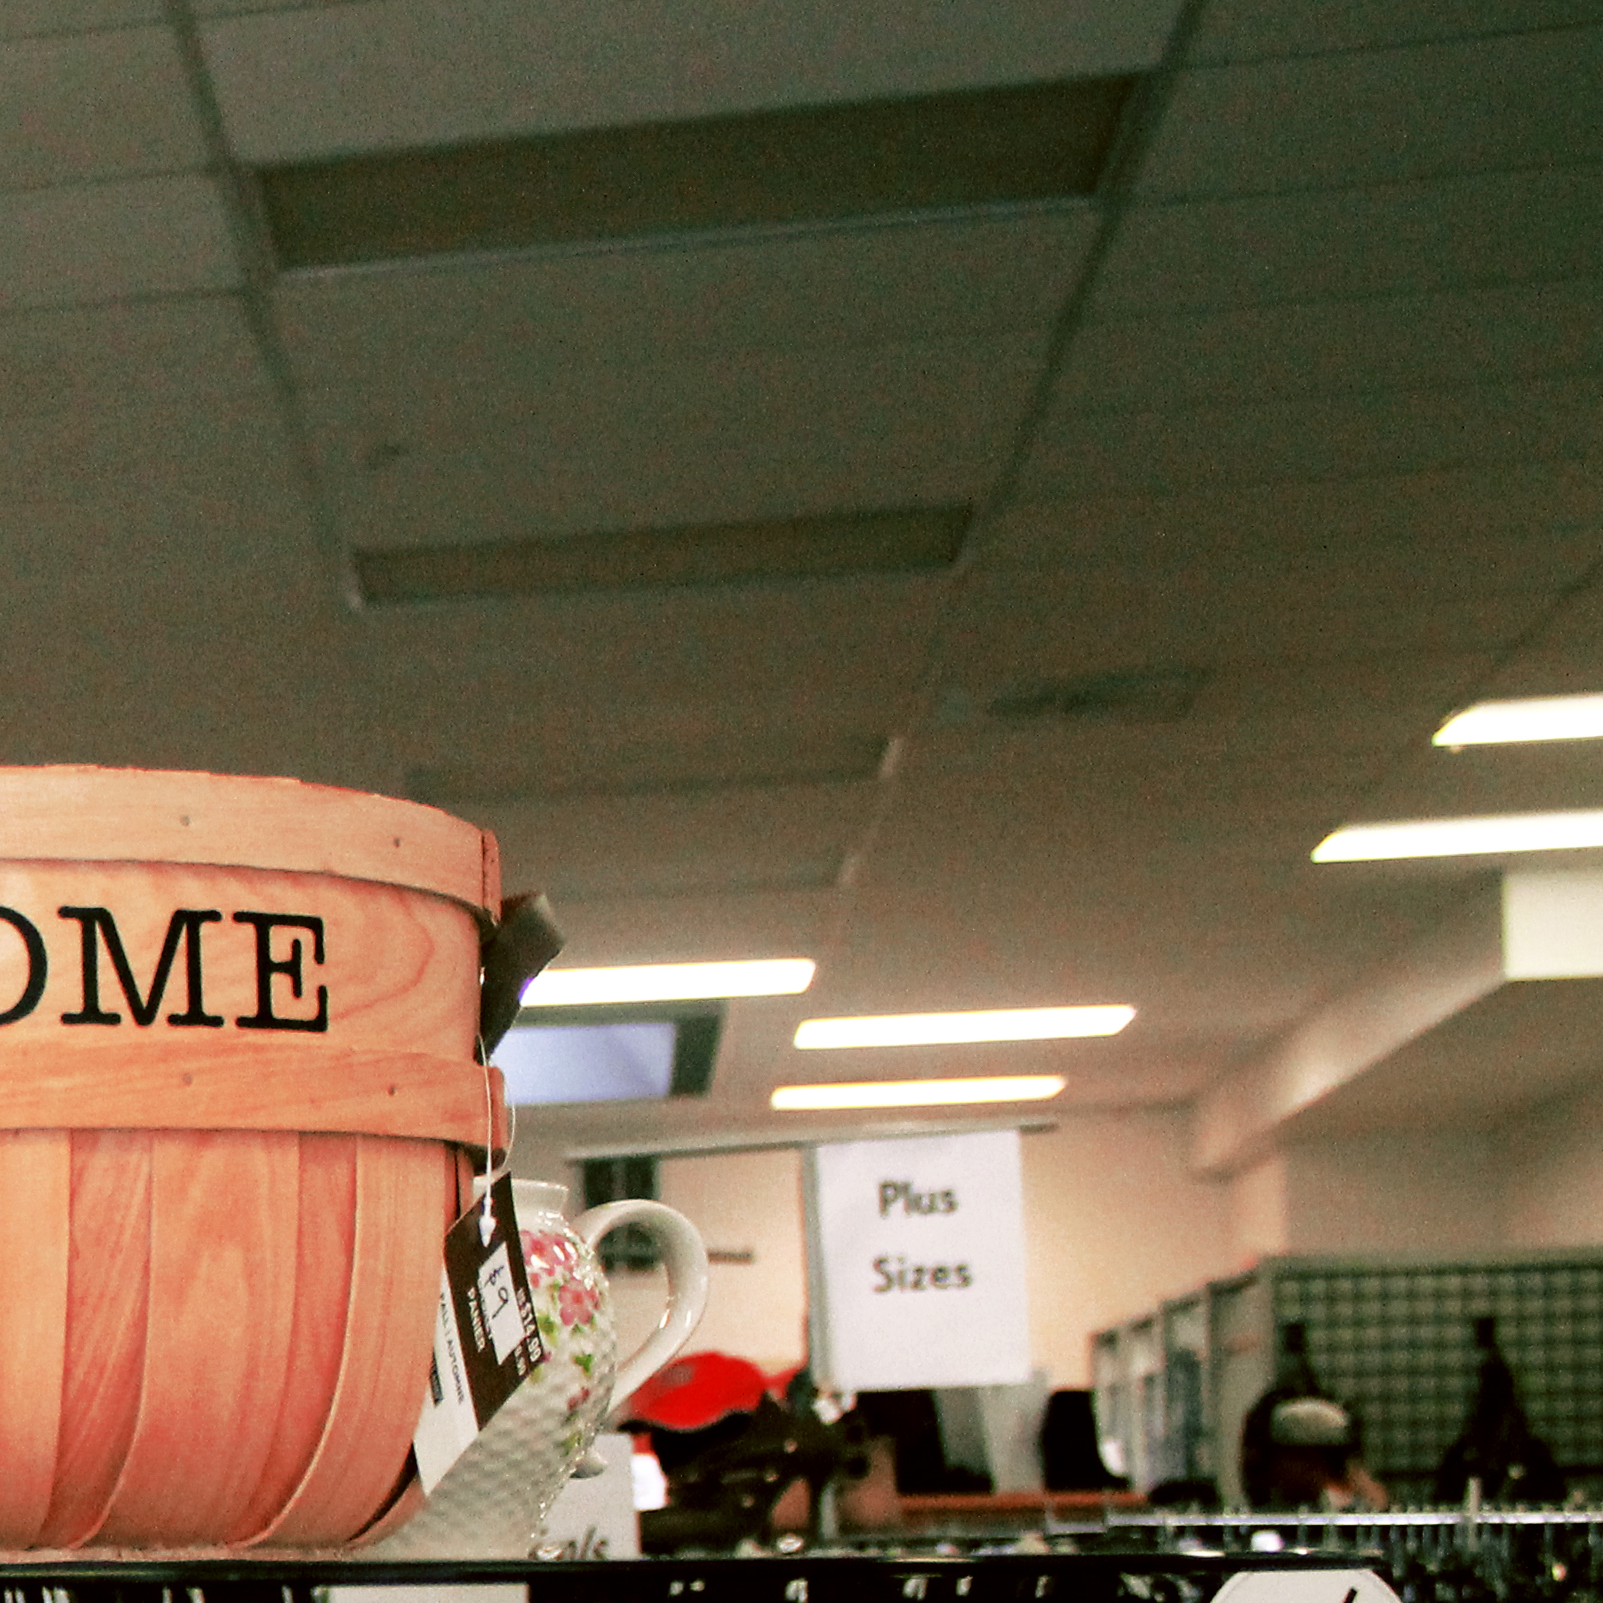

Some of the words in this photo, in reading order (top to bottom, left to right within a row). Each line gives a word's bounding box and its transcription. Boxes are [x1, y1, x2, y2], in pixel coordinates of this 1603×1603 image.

[877, 1178, 959, 1217] Plus
[872, 1256, 973, 1293] Sizes
[467, 1286, 486, 1354] PANIER
